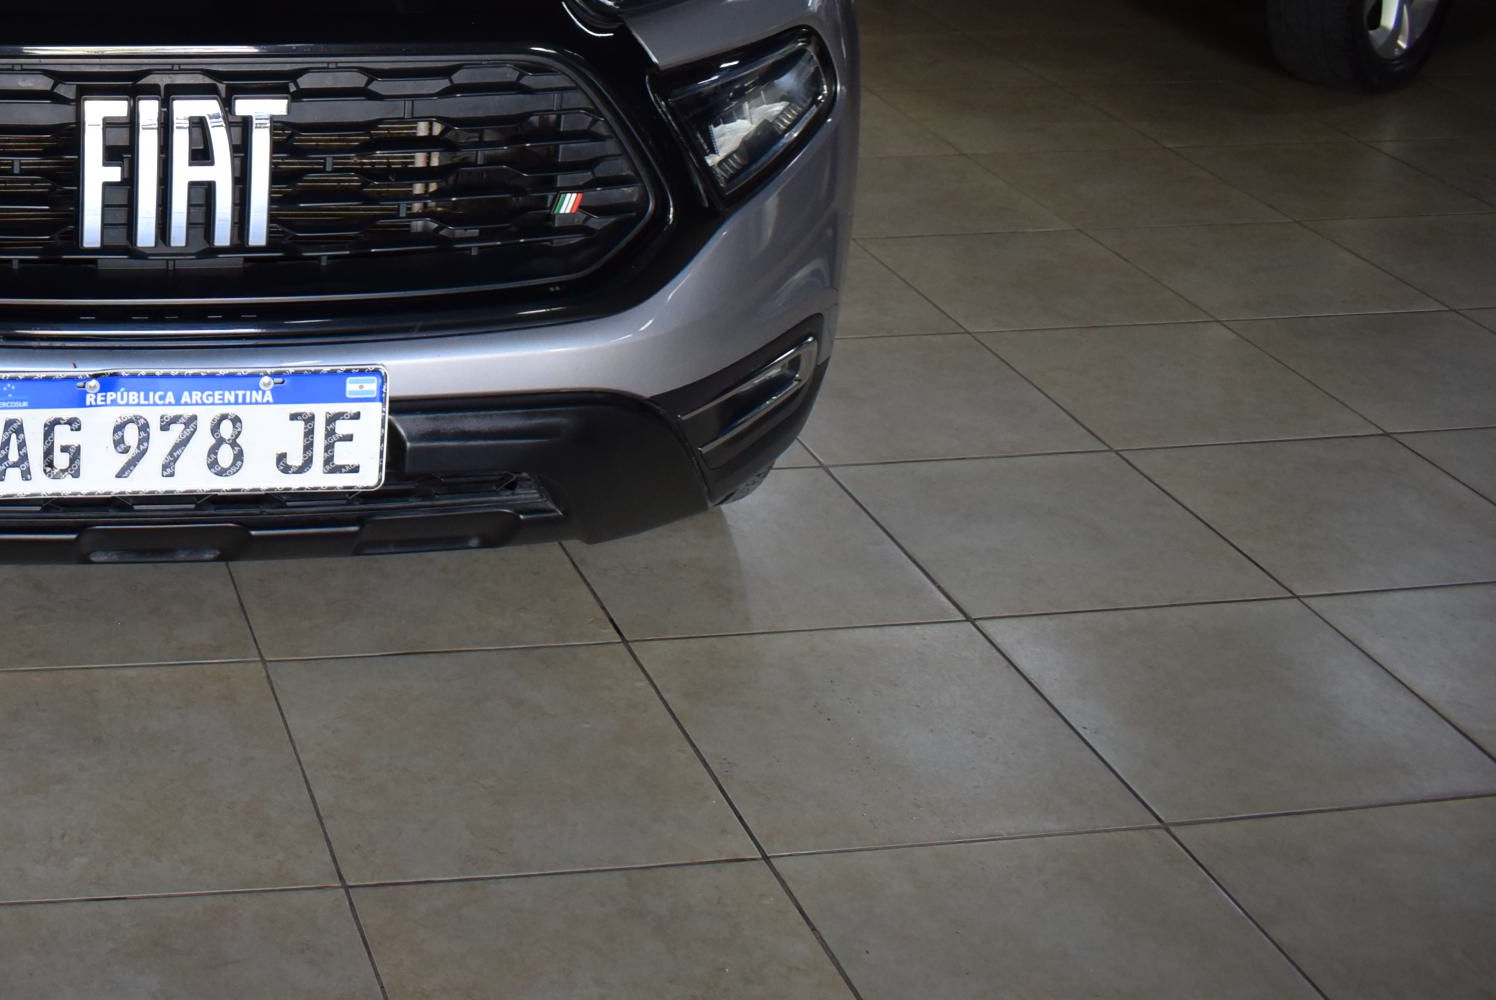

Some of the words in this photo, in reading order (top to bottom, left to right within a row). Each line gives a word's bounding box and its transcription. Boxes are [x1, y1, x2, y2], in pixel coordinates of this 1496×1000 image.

[78, 94, 290, 249] FIAT
[85, 387, 175, 406] REPÚBLICA
[180, 389, 274, 404] ARGENTINA
[112, 412, 245, 479] 978
[275, 410, 361, 475] JE
